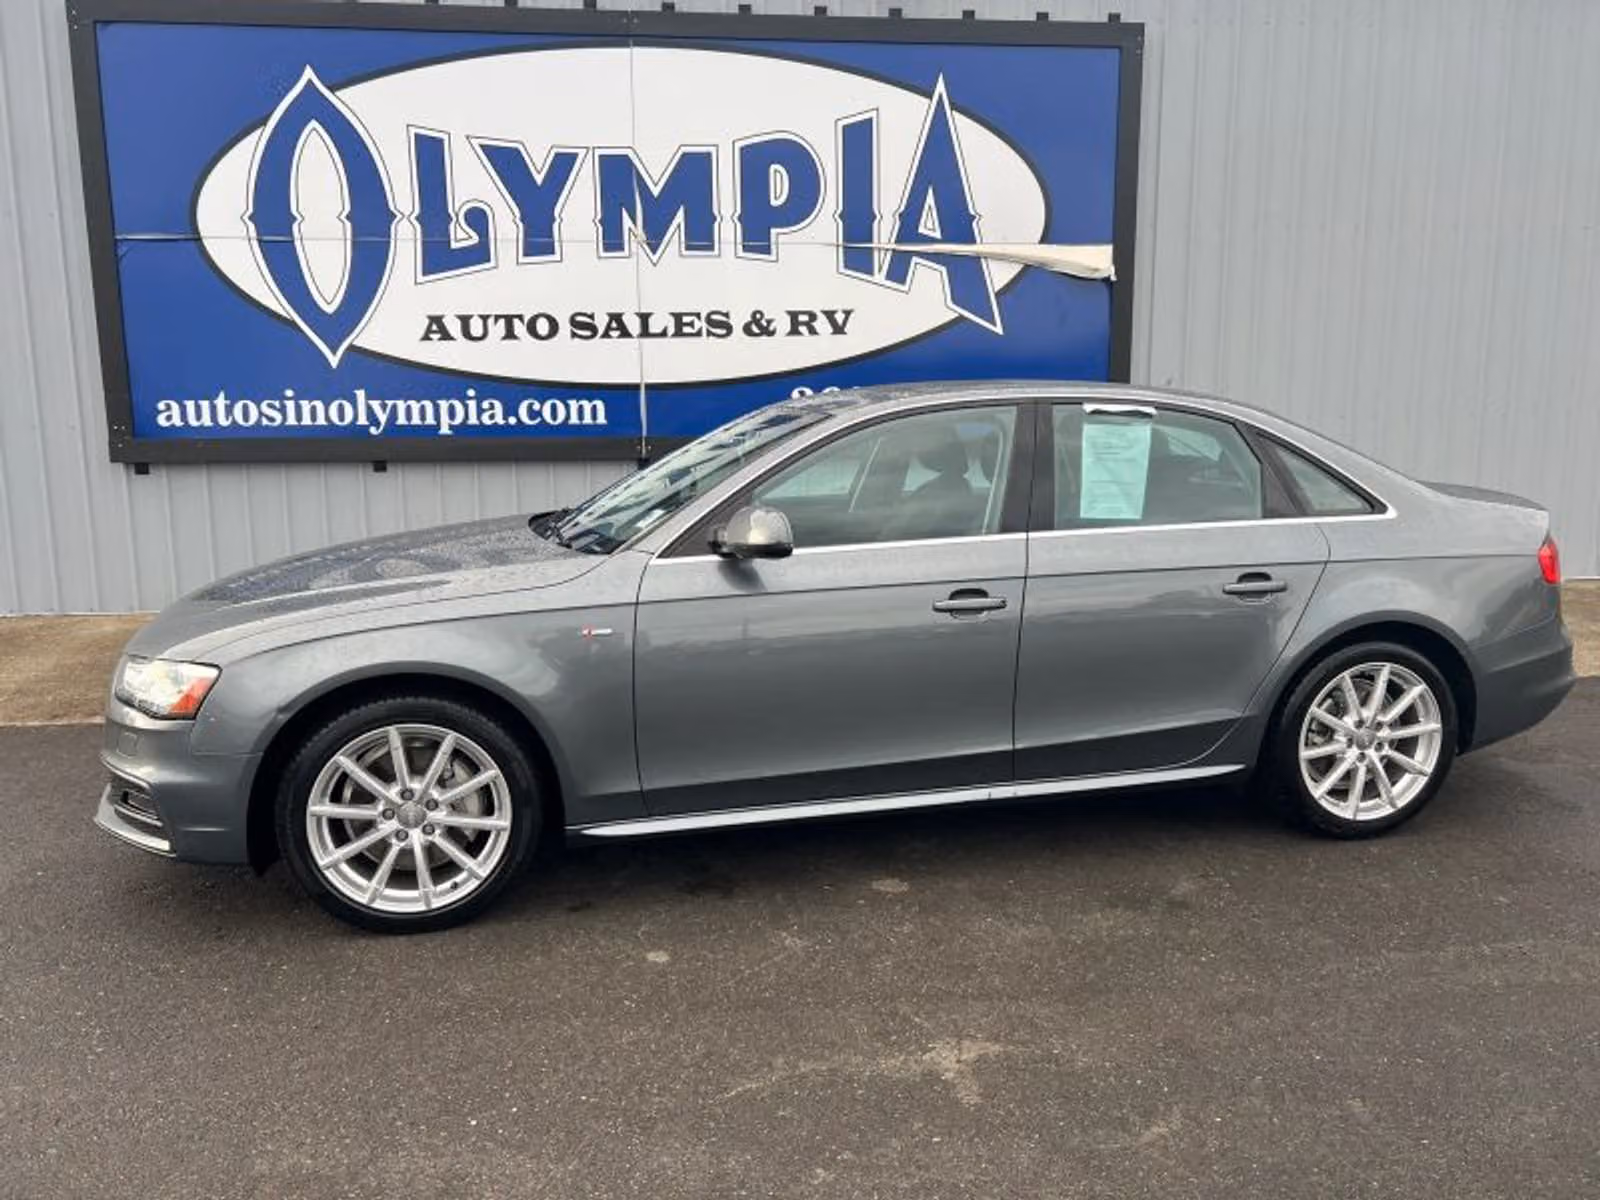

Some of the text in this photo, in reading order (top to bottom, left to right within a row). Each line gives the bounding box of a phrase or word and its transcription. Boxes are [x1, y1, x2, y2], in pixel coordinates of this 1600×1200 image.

[243, 66, 1003, 368] OLYMPIA
[420, 308, 854, 342] AUTO SALES & RV
[155, 389, 608, 435] autosinolympia.com
